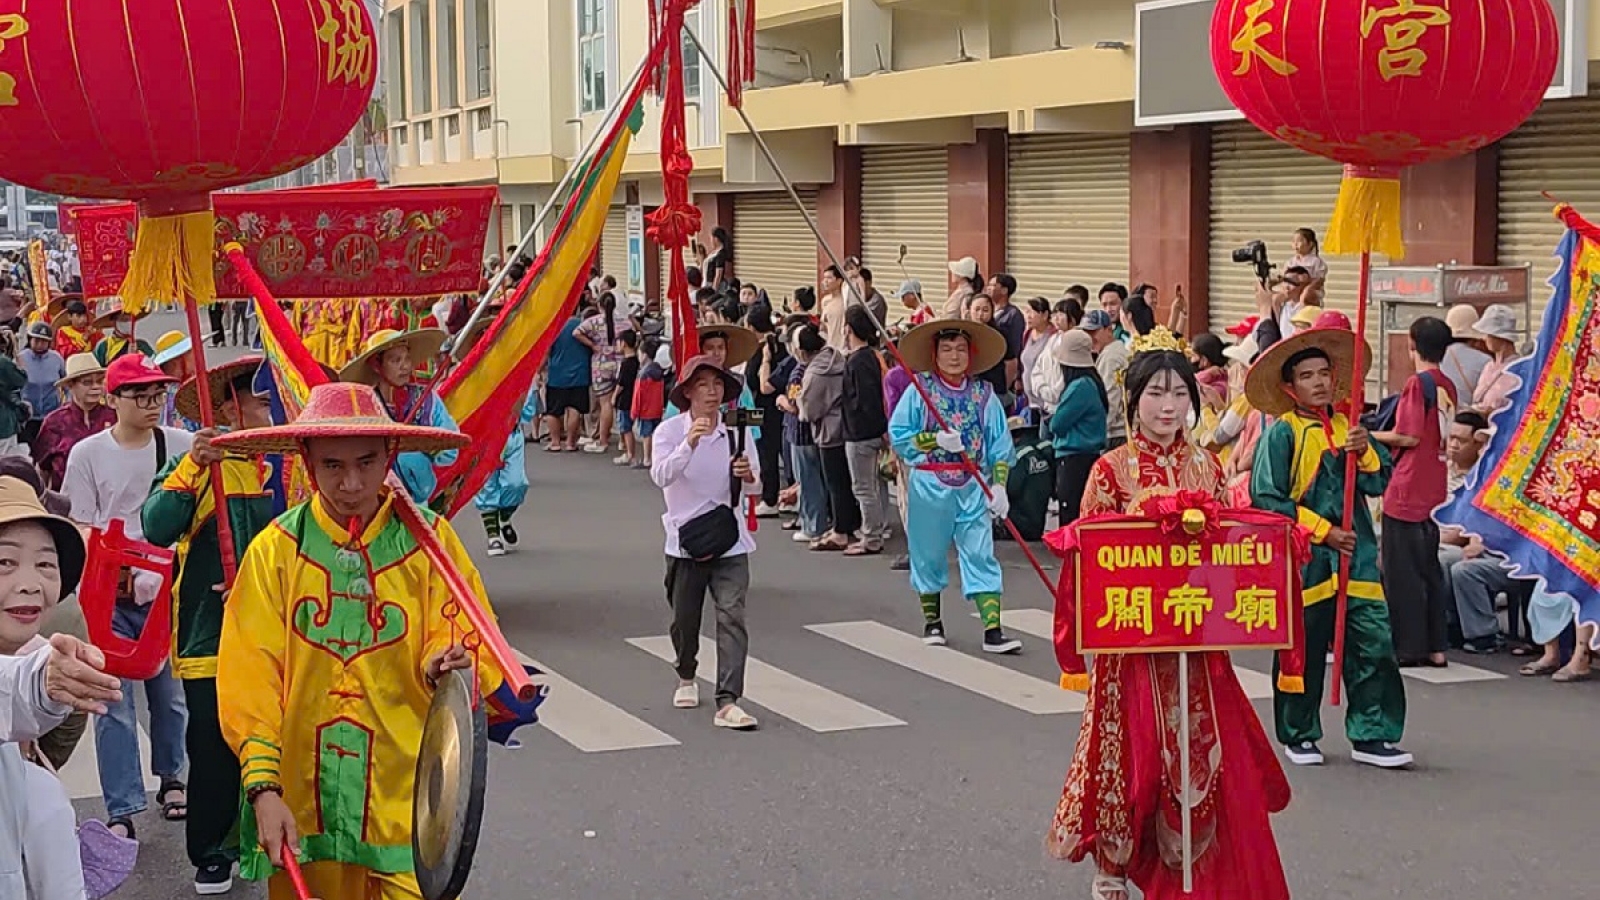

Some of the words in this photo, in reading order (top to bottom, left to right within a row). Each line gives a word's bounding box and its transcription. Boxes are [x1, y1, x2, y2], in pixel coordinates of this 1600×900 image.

[1097, 545, 1162, 571] QUAN
[1211, 533, 1273, 567] MIẾU
[1096, 582, 1277, 635] 關帝廟
